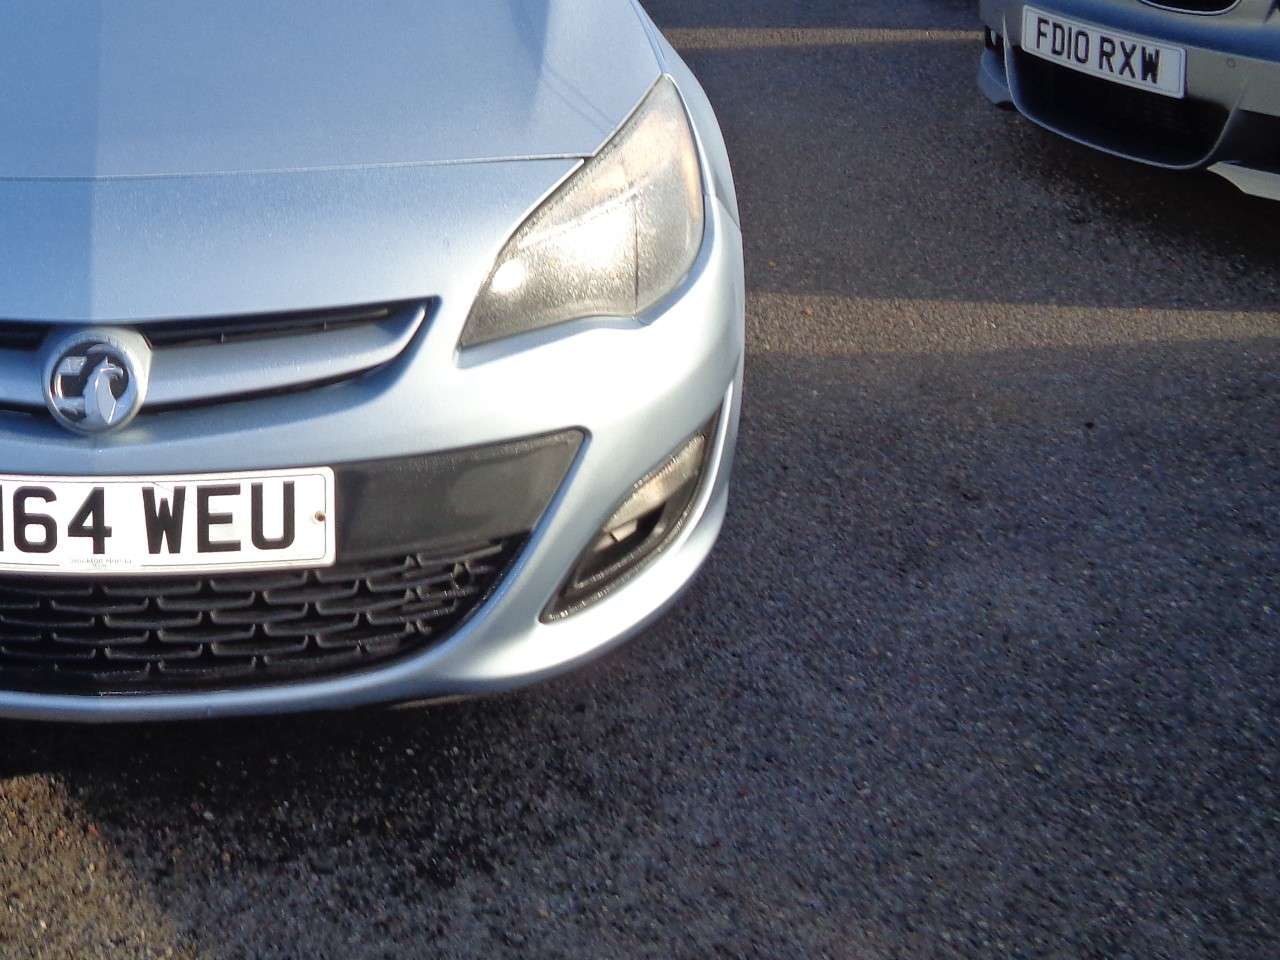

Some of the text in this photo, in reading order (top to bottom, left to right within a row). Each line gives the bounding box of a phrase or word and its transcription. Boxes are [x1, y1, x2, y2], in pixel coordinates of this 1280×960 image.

[1037, 16, 1160, 84] FD10 RXW
[141, 479, 296, 555] WEU
